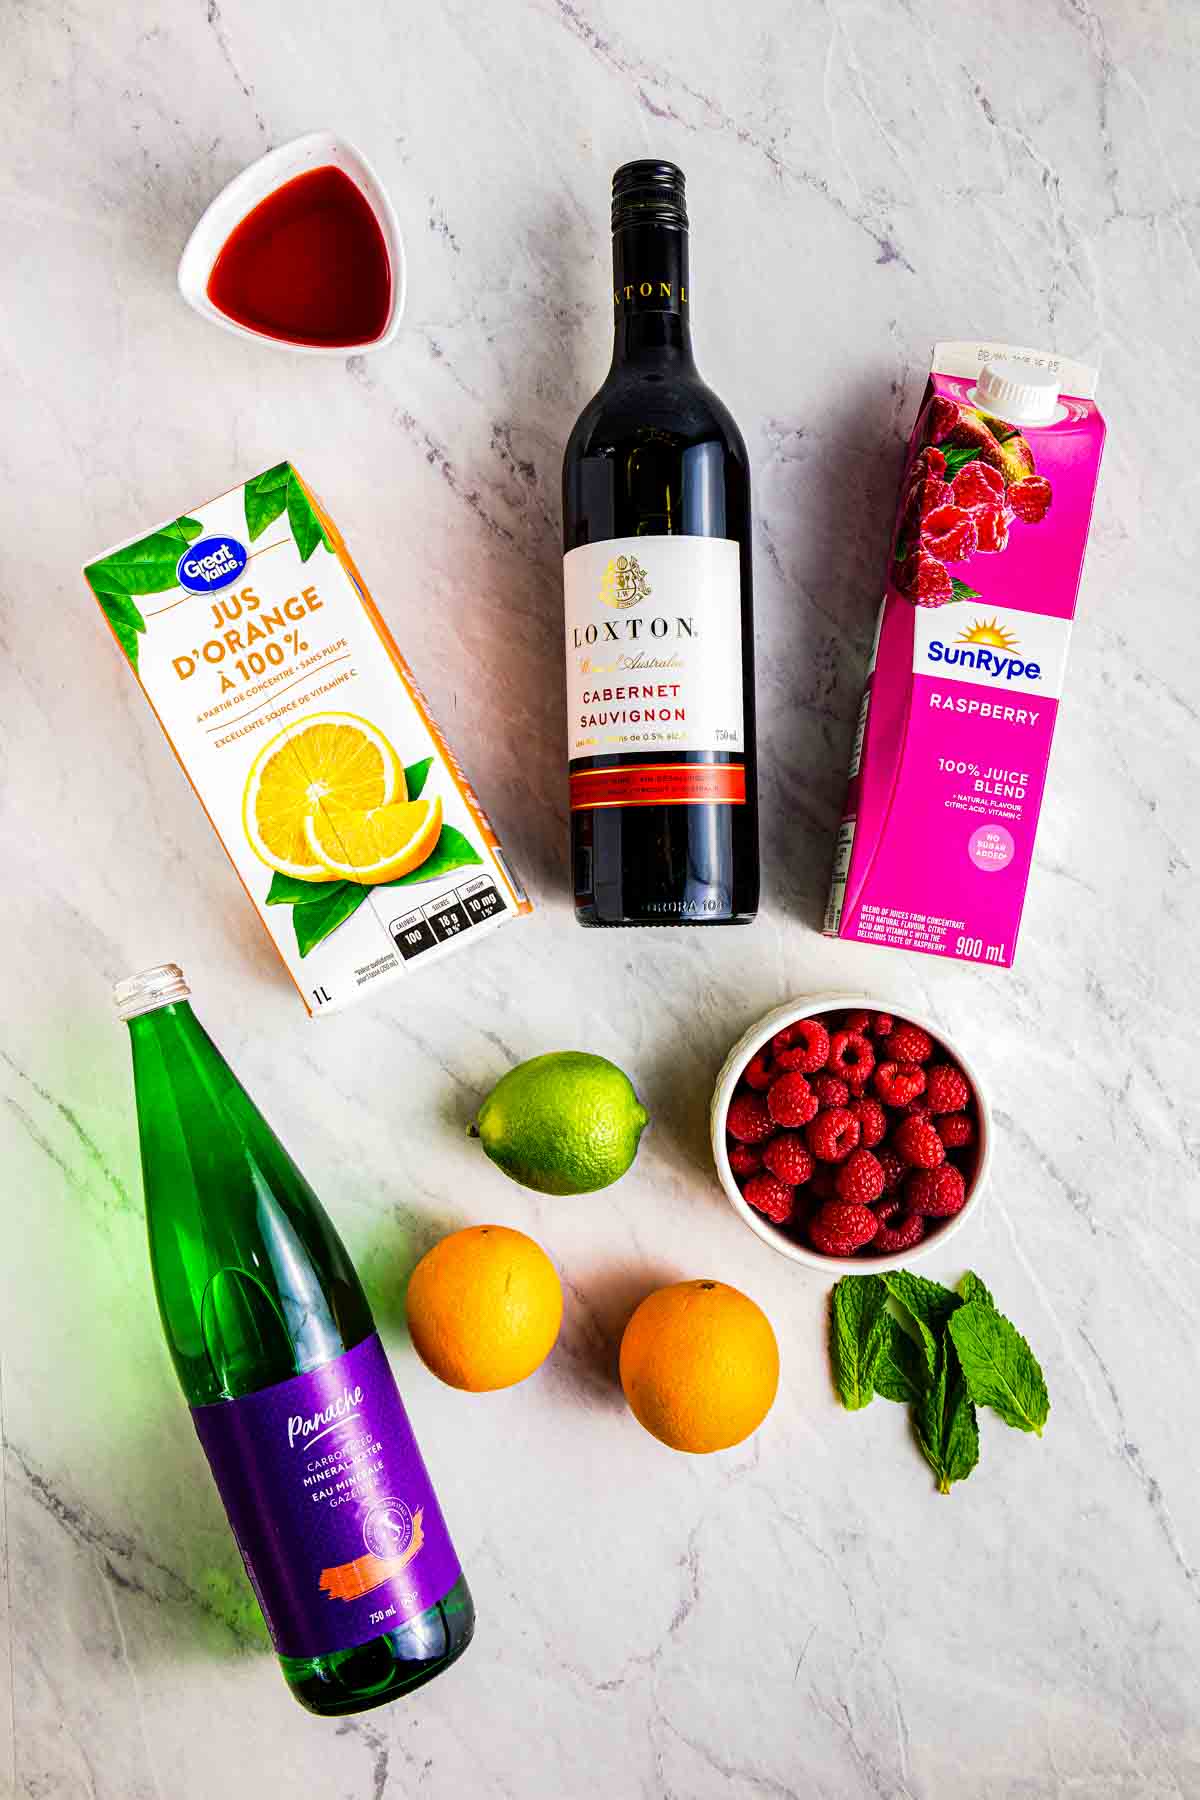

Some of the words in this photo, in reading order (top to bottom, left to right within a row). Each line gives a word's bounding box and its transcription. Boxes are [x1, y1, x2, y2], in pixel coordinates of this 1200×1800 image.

[183, 543, 234, 578] Great
[210, 587, 261, 629] JUS
[573, 617, 694, 648] LOXTON
[216, 670, 237, 694] À
[235, 629, 309, 681] 100%
[928, 640, 1041, 681] SunRype
[203, 700, 233, 720] PARTIR
[233, 693, 246, 705] DE
[299, 653, 323, 669] SANS
[322, 638, 348, 657] PULPE
[582, 684, 681, 704] CABERNET
[214, 717, 265, 749] EXCELLENTE
[264, 700, 298, 723] SOURCE
[297, 694, 311, 705] DE
[310, 672, 350, 697] VITAMINE
[350, 668, 358, 677] C
[580, 707, 686, 728] SAUVIGNON
[929, 693, 1040, 727] RASPBERRY
[937, 757, 980, 777] 100%
[983, 767, 1030, 786] JUICE
[957, 794, 990, 806] NATURAL
[974, 779, 1025, 799] BLEND
[944, 800, 968, 811] CITRIC
[988, 808, 1016, 820] VITAMIN
[976, 840, 1007, 851] SUGAR
[986, 833, 1000, 842] NO
[468, 899, 481, 912] 10
[480, 893, 497, 907] mg
[395, 915, 417, 930] CALORIES
[438, 915, 451, 928] 18
[450, 913, 459, 924] g
[860, 912, 875, 922] WITH
[875, 915, 900, 927] NATURAL
[927, 925, 947, 935] CITRIC
[861, 904, 880, 915] BLEND
[881, 908, 889, 916] OF
[889, 909, 909, 920] JUICES
[909, 912, 926, 923] FROM
[926, 916, 966, 930] CONCENTRATE
[404, 929, 422, 945] 100
[857, 929, 887, 940] DELICIOUS
[887, 934, 903, 944] TASTE
[912, 939, 947, 952] RASPBERRY
[858, 920, 873, 930] ACID
[872, 923, 885, 932] AND
[885, 926, 908, 937] VITAMIN
[914, 931, 929, 941] WITH
[929, 934, 941, 943] THE
[955, 935, 983, 959] 900
[985, 943, 1007, 964] mL
[287, 1385, 364, 1449] Panache
[303, 1461, 351, 1487] MINERAL
[311, 1487, 334, 1502] EAU
[369, 1610, 385, 1625] 750
[385, 1604, 397, 1617] mL
